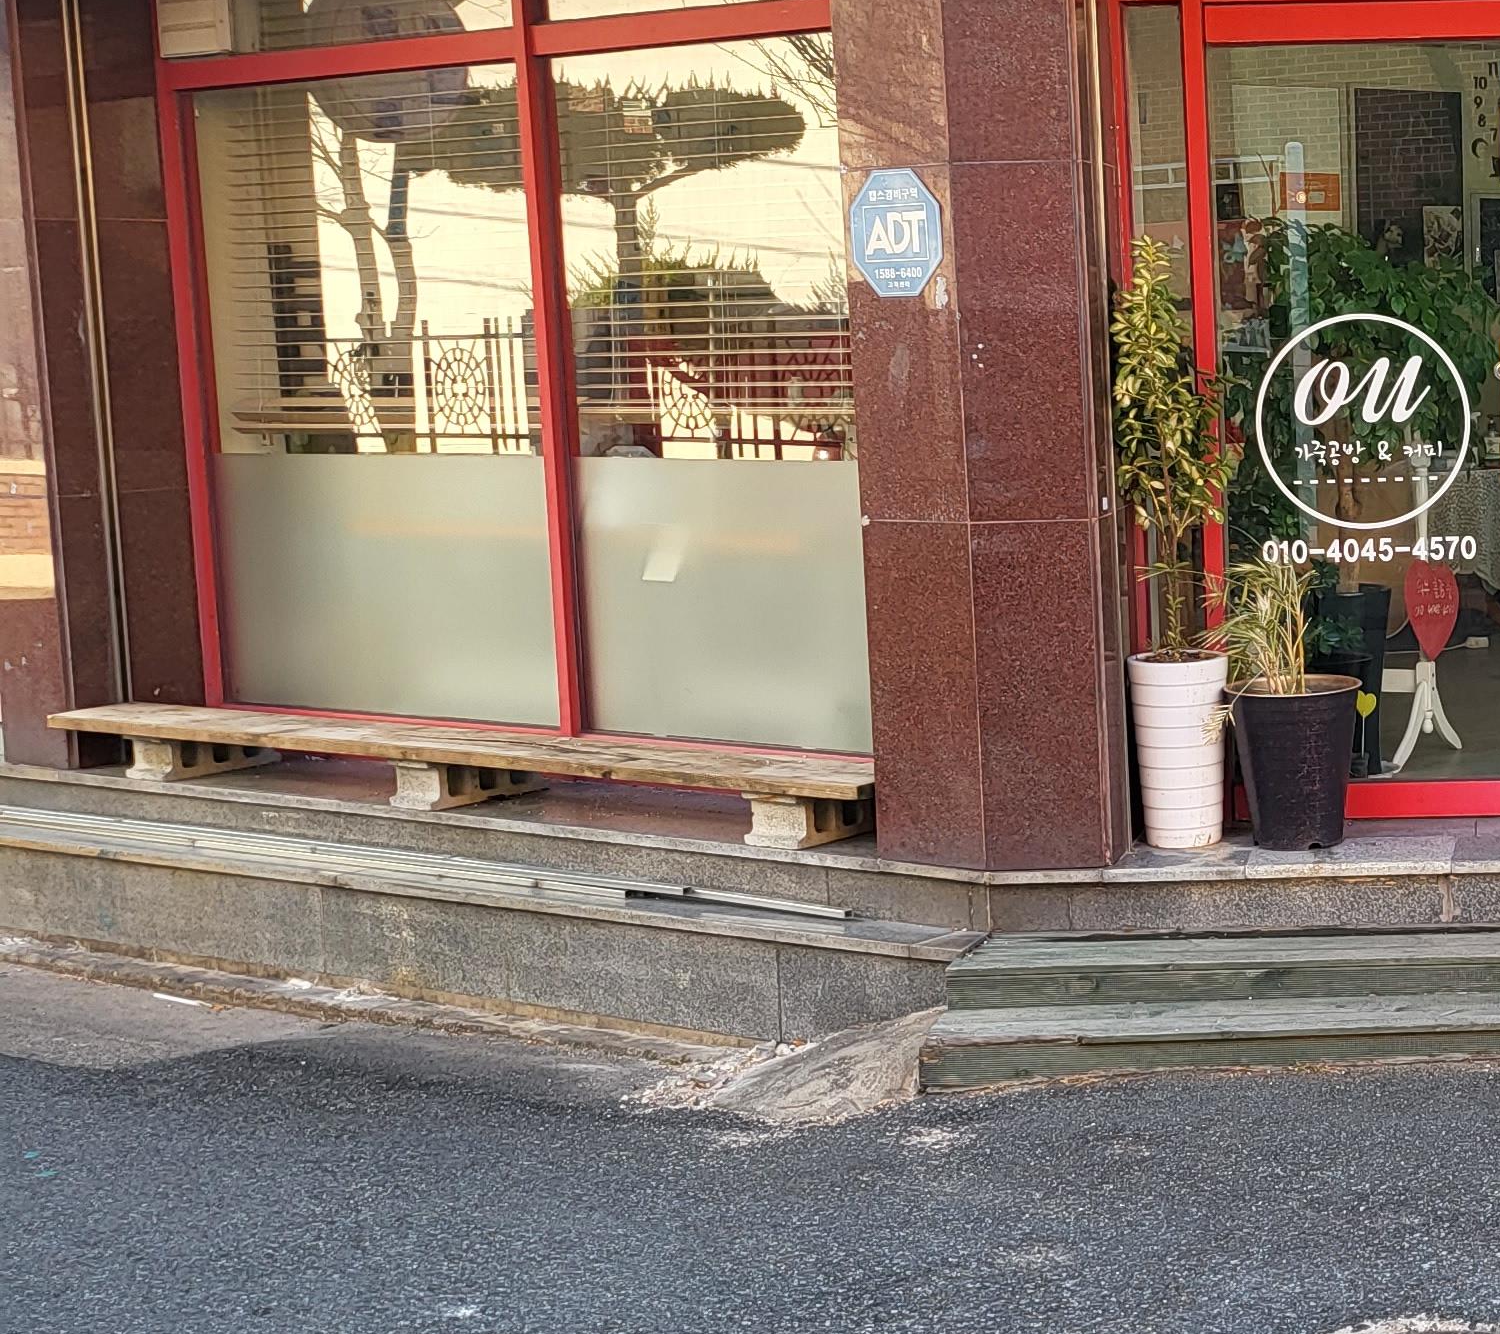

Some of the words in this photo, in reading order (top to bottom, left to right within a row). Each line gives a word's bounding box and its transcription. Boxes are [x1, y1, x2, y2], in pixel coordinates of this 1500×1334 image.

[1473, 76, 1487, 89] 10
[1474, 95, 1483, 108] 9
[1478, 113, 1486, 127] 8
[1490, 127, 1498, 141] 7
[865, 210, 927, 256] ADT
[874, 266, 923, 280] 1588-6400
[1294, 440, 1366, 467] 가죽공방
[1377, 441, 1393, 461] &
[1402, 440, 1443, 459] 커피
[1262, 535, 1477, 564] 010-4045-4570
